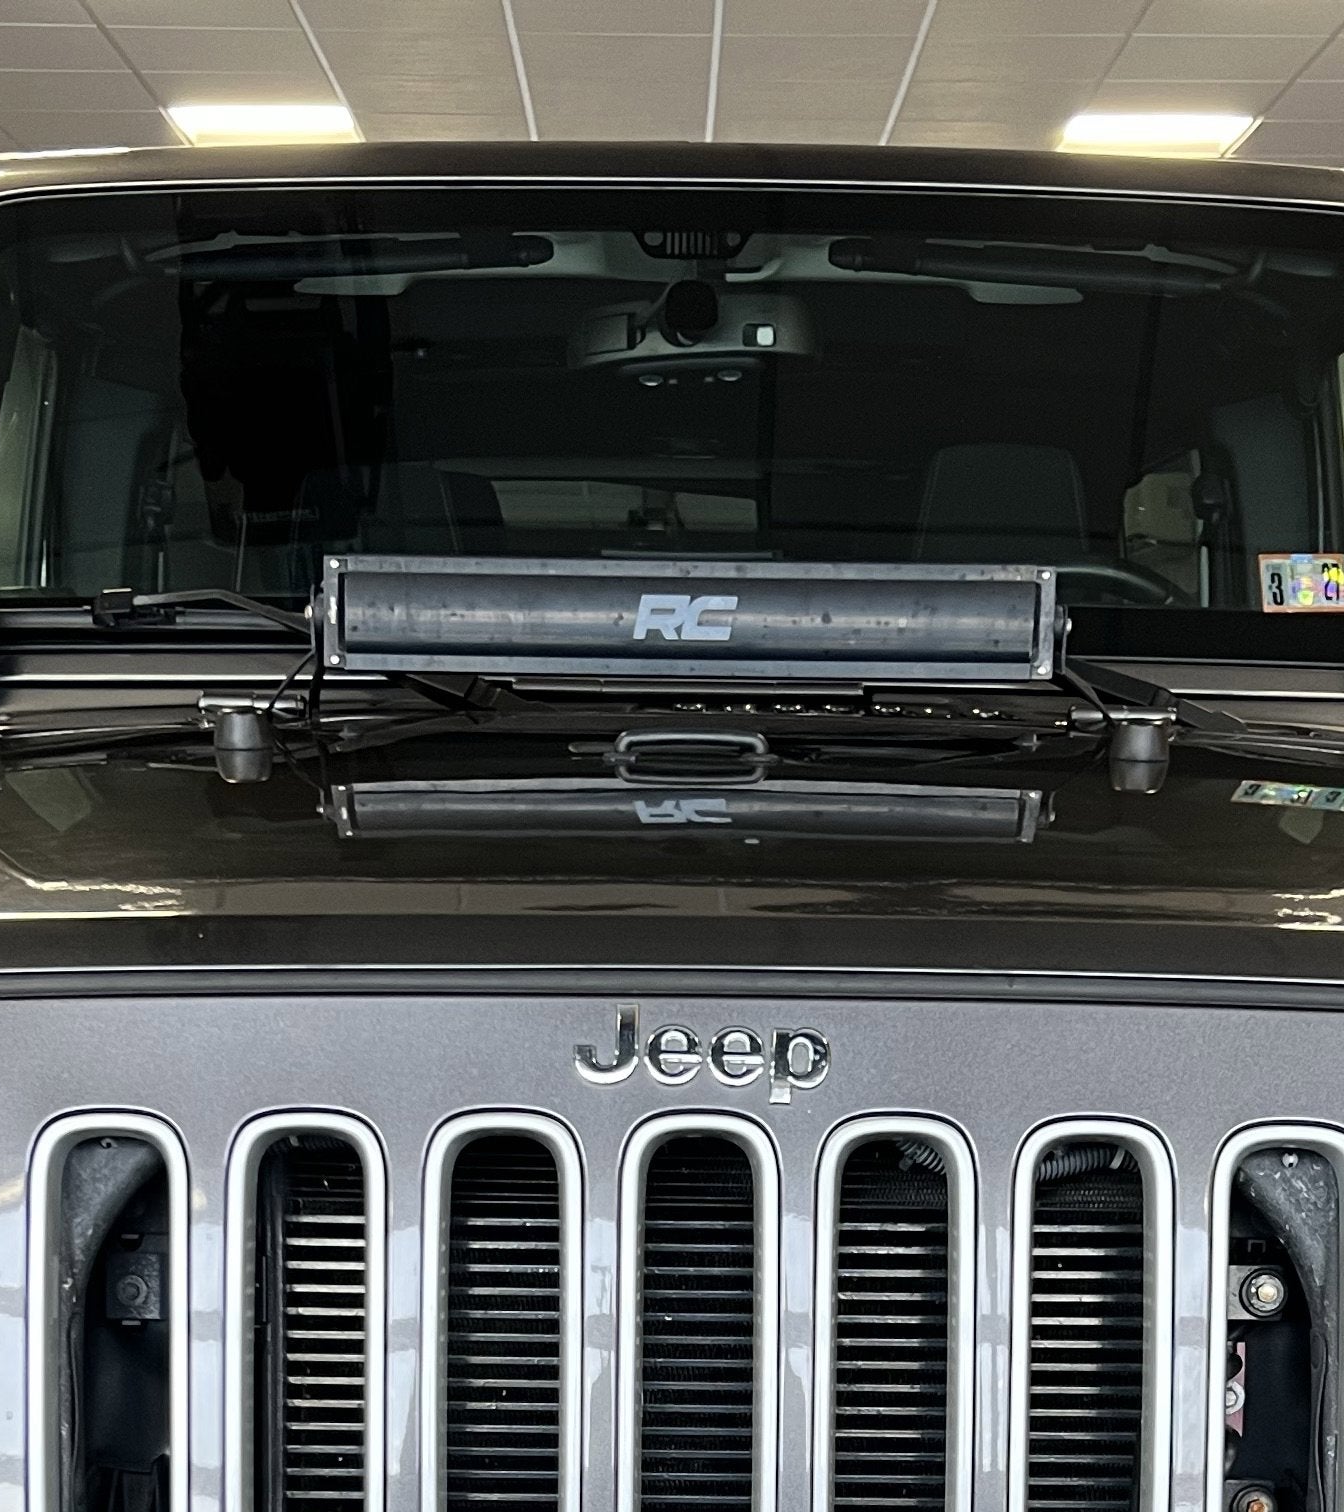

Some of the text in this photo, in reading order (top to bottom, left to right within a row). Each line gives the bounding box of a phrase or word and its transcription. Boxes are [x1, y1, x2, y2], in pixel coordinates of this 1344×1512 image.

[1269, 572, 1285, 606] 3
[633, 594, 739, 641] RC
[572, 1003, 832, 1104] Jeep
